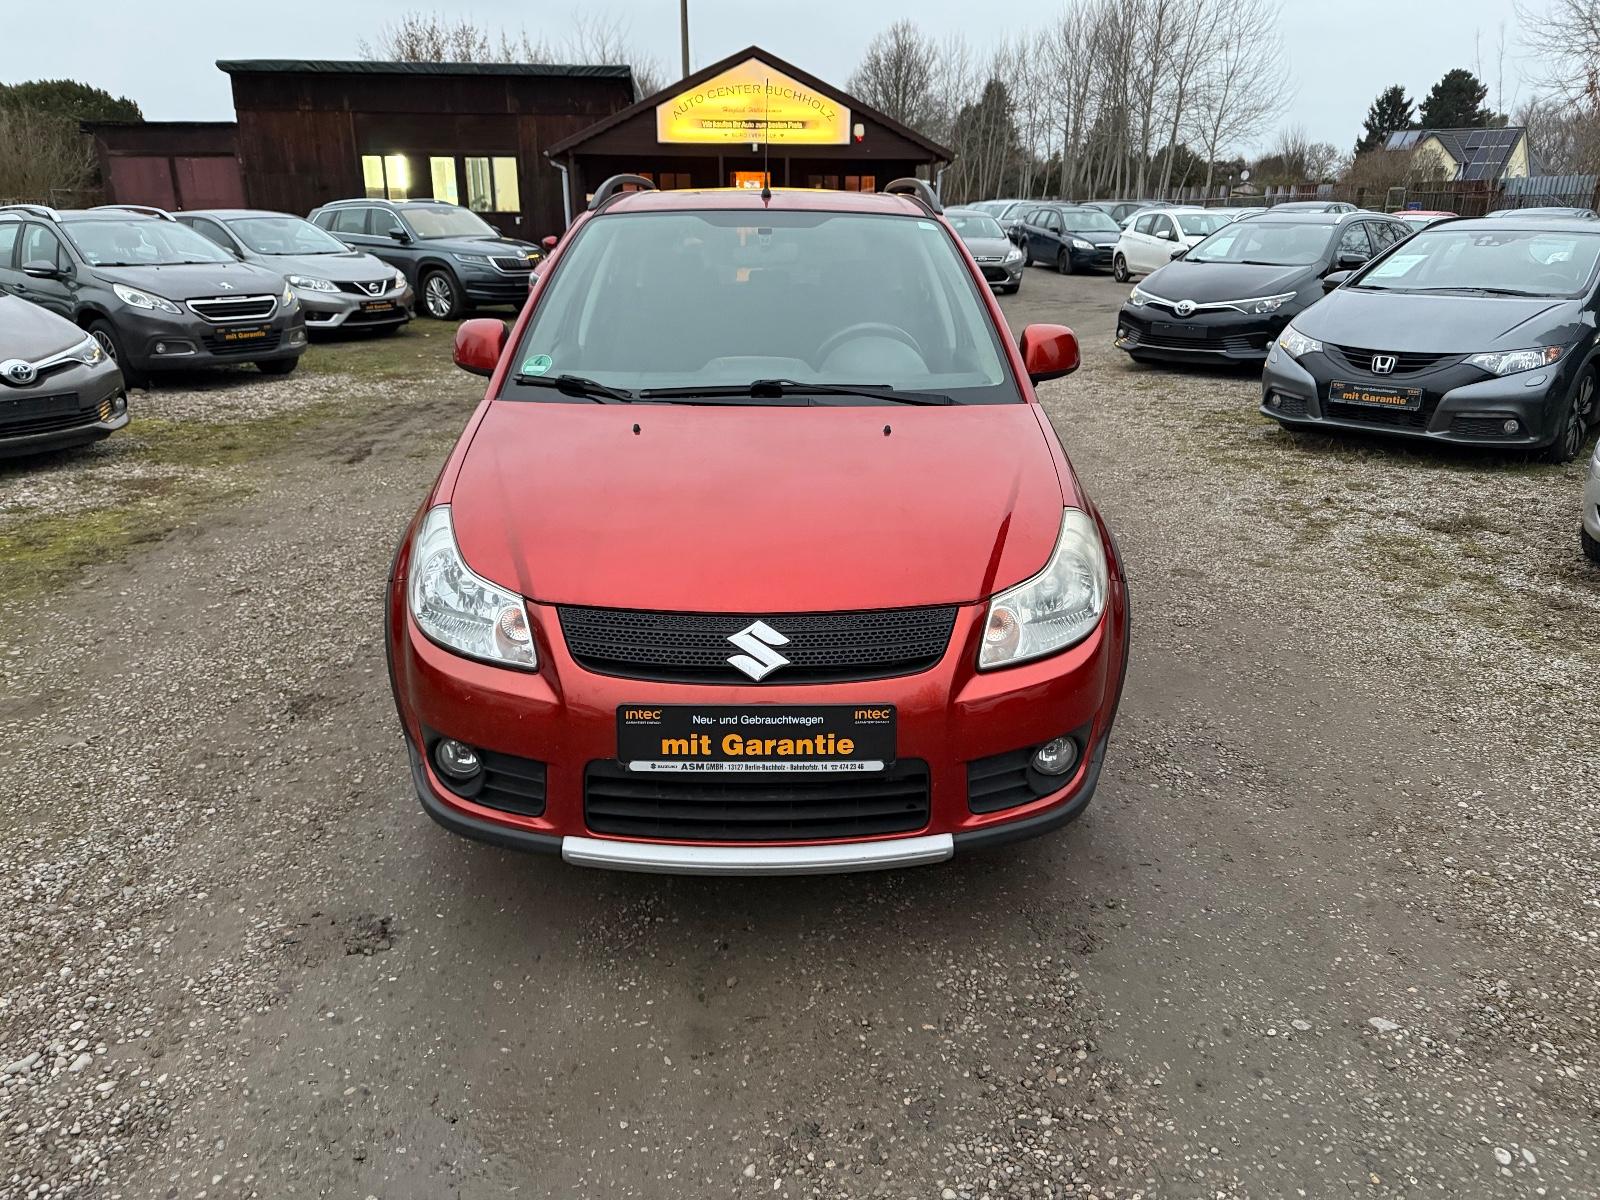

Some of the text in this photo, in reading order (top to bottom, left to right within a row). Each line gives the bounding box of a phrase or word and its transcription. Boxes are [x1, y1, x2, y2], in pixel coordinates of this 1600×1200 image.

[672, 84, 836, 122] AUTO CENTER BUCHHOLZ
[1342, 392, 1407, 405] mit Garantie
[625, 709, 662, 720] intec
[854, 709, 891, 720] intec
[692, 715, 824, 727] Neu- und Gebrauchtwagen
[661, 733, 855, 756] mit Garantie
[681, 763, 705, 771] ASM
[705, 763, 724, 771] GMBH
[728, 763, 744, 771] 13127
[744, 763, 786, 771] Berlin-Buchholz
[789, 763, 820, 771] Bahnhofstr.
